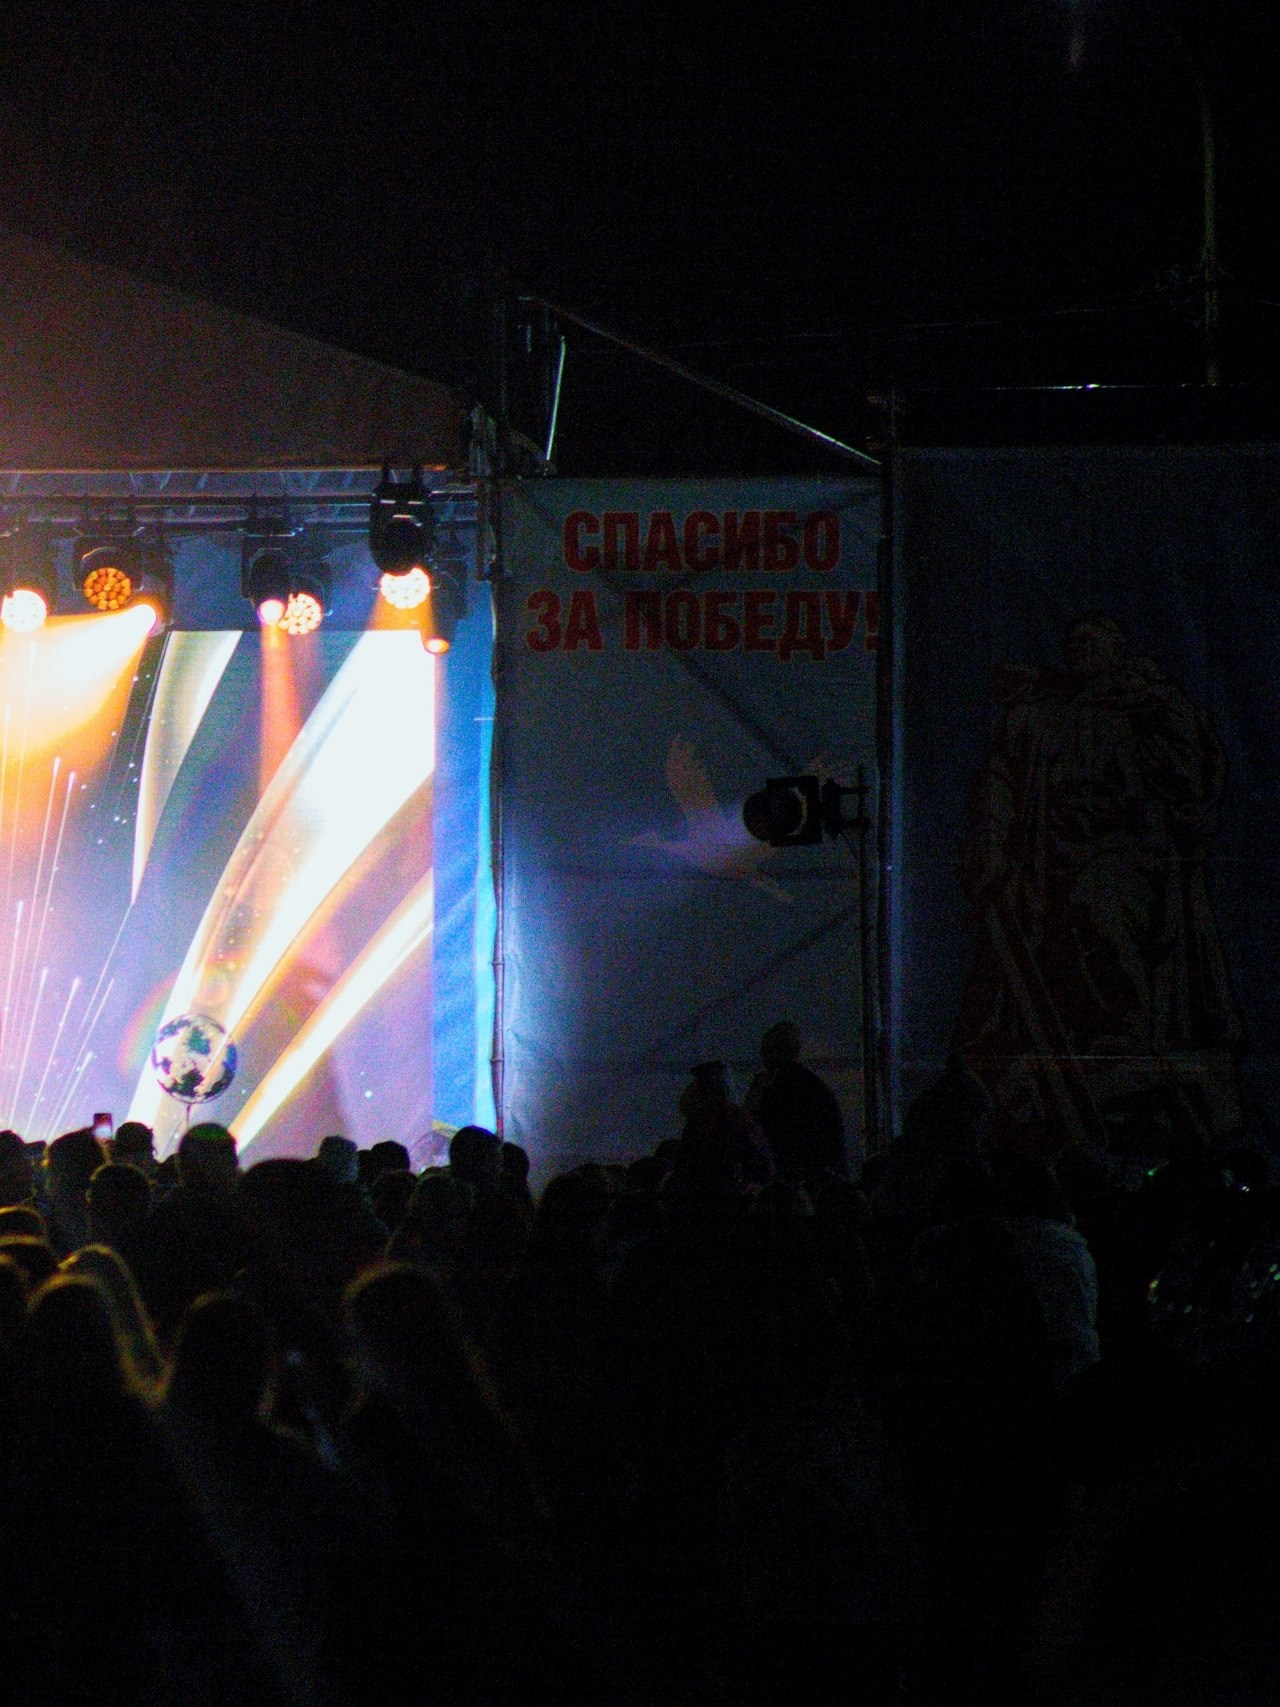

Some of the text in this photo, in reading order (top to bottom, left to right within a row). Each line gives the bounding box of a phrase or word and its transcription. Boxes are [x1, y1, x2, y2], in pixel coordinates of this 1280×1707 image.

[563, 510, 840, 572] СПАСИБО
[526, 590, 880, 662] ЗА ПОБЕДУ!
